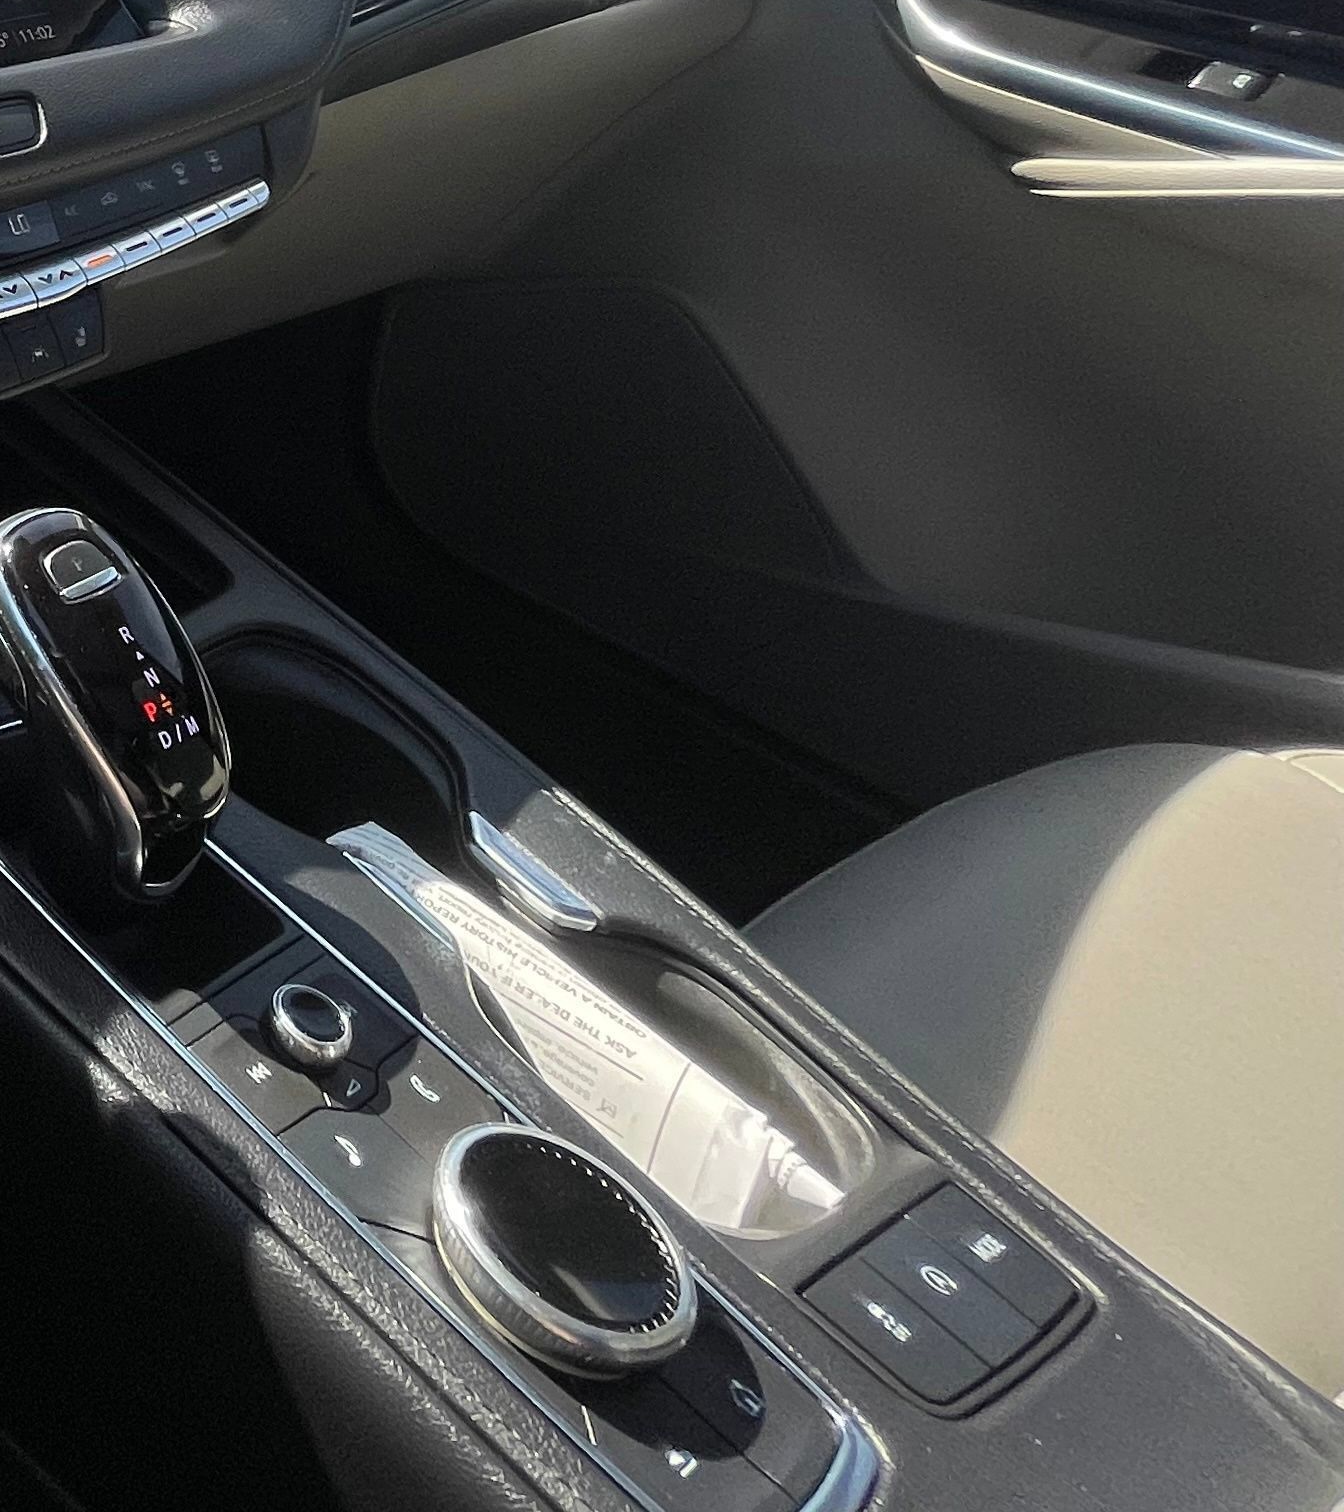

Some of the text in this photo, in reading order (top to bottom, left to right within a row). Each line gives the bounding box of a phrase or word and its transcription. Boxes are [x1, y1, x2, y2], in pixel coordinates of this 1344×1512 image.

[19, 24, 57, 44] 11:02
[118, 626, 135, 644] R
[143, 667, 160, 688] N
[143, 701, 157, 723] P
[461, 922, 518, 958] HISTORY
[513, 980, 571, 1021] DEALER
[572, 1016, 601, 1039] THE
[603, 1035, 637, 1061] ASK
